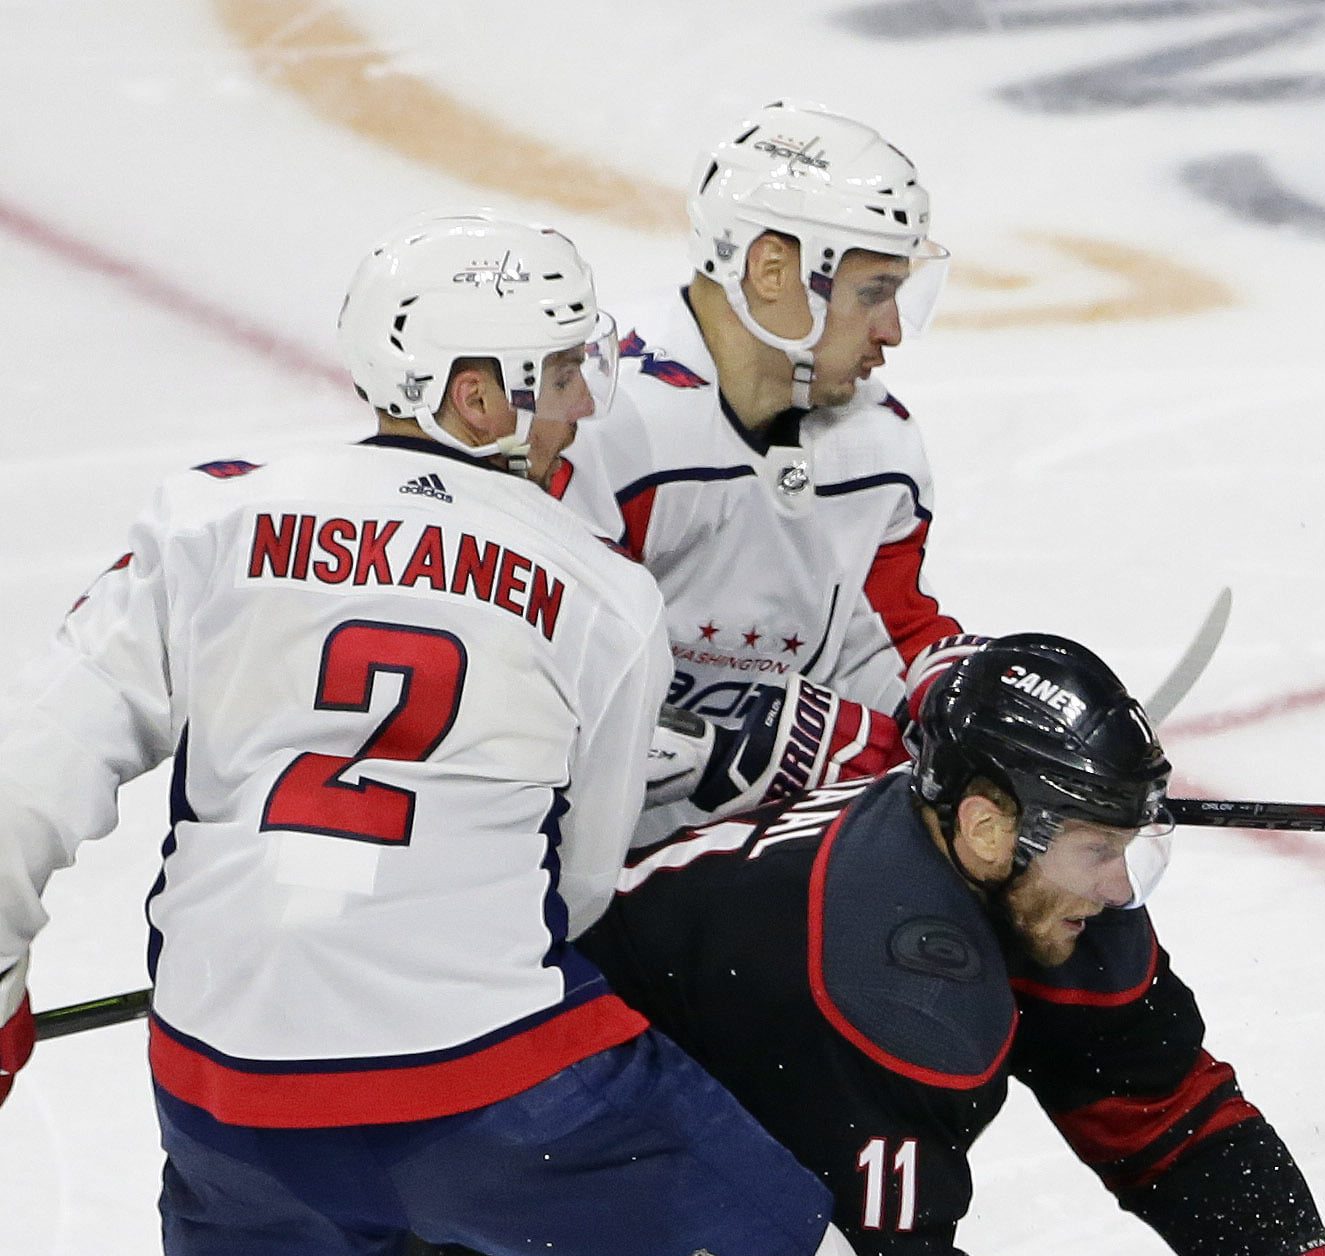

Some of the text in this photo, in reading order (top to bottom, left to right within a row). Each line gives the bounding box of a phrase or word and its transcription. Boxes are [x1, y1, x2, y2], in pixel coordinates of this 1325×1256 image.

[399, 485, 454, 503] adidas
[247, 513, 565, 642] NISKANEN
[259, 618, 468, 847] 2
[856, 1136, 920, 1232] 11
